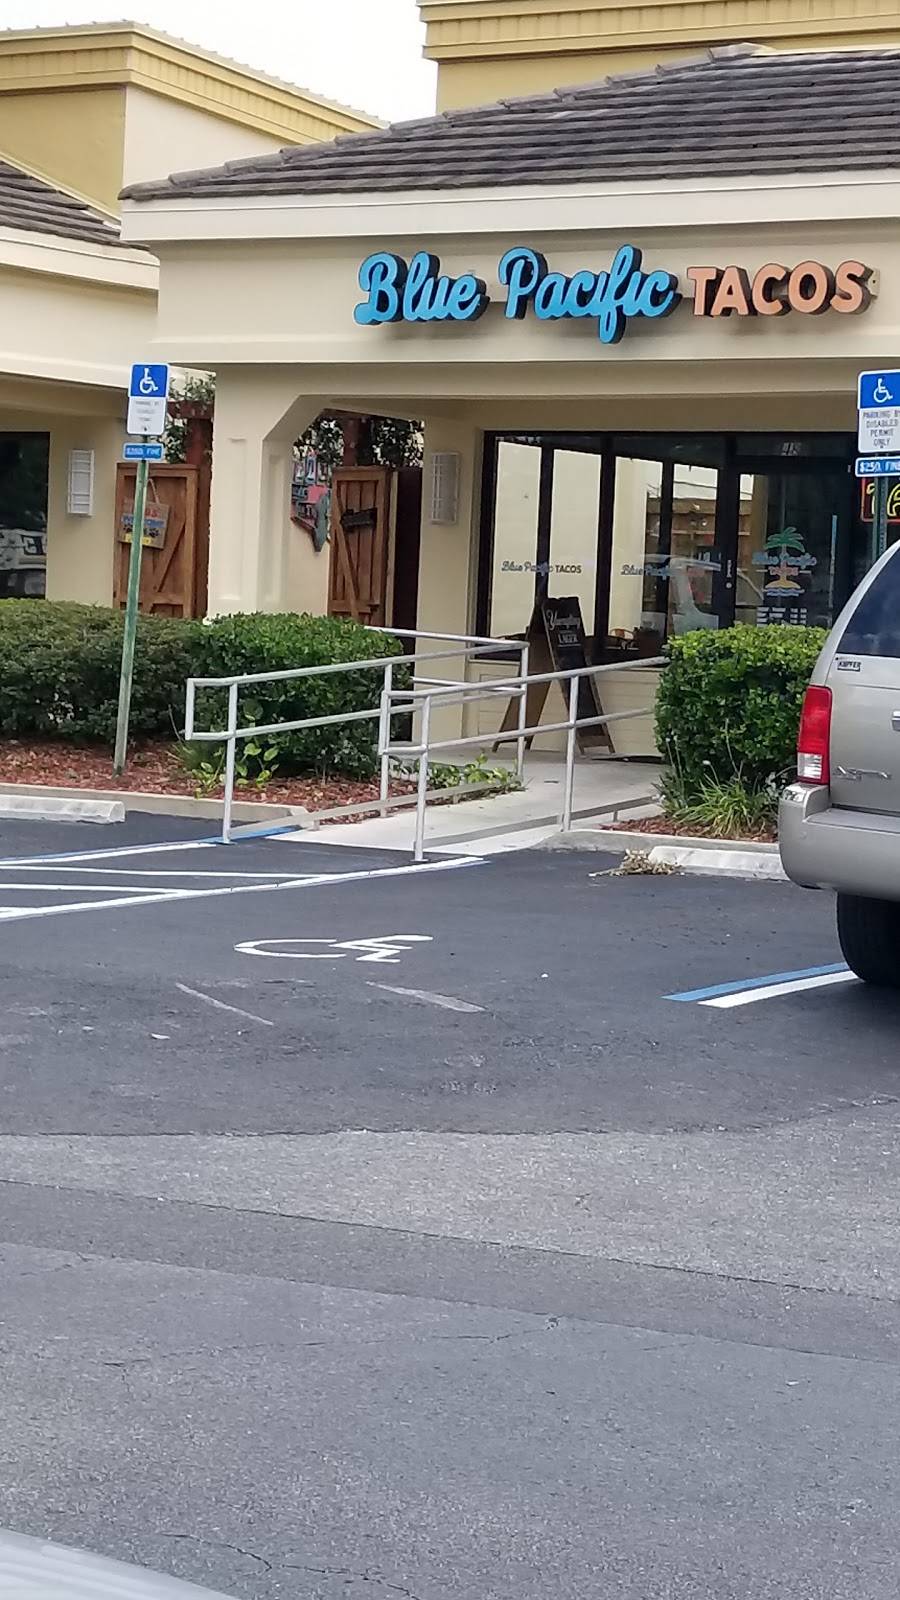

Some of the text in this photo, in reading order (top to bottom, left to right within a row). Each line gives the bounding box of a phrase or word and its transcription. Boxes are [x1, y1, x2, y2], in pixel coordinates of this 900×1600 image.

[354, 244, 871, 343] Blue Pacific TACOS
[866, 419, 898, 428] DISABLED
[870, 429, 894, 437] PERMIT
[873, 438, 890, 447] ONLY
[501, 561, 523, 572] Blue
[555, 565, 582, 574] TACOS
[621, 565, 642, 576] Blue
